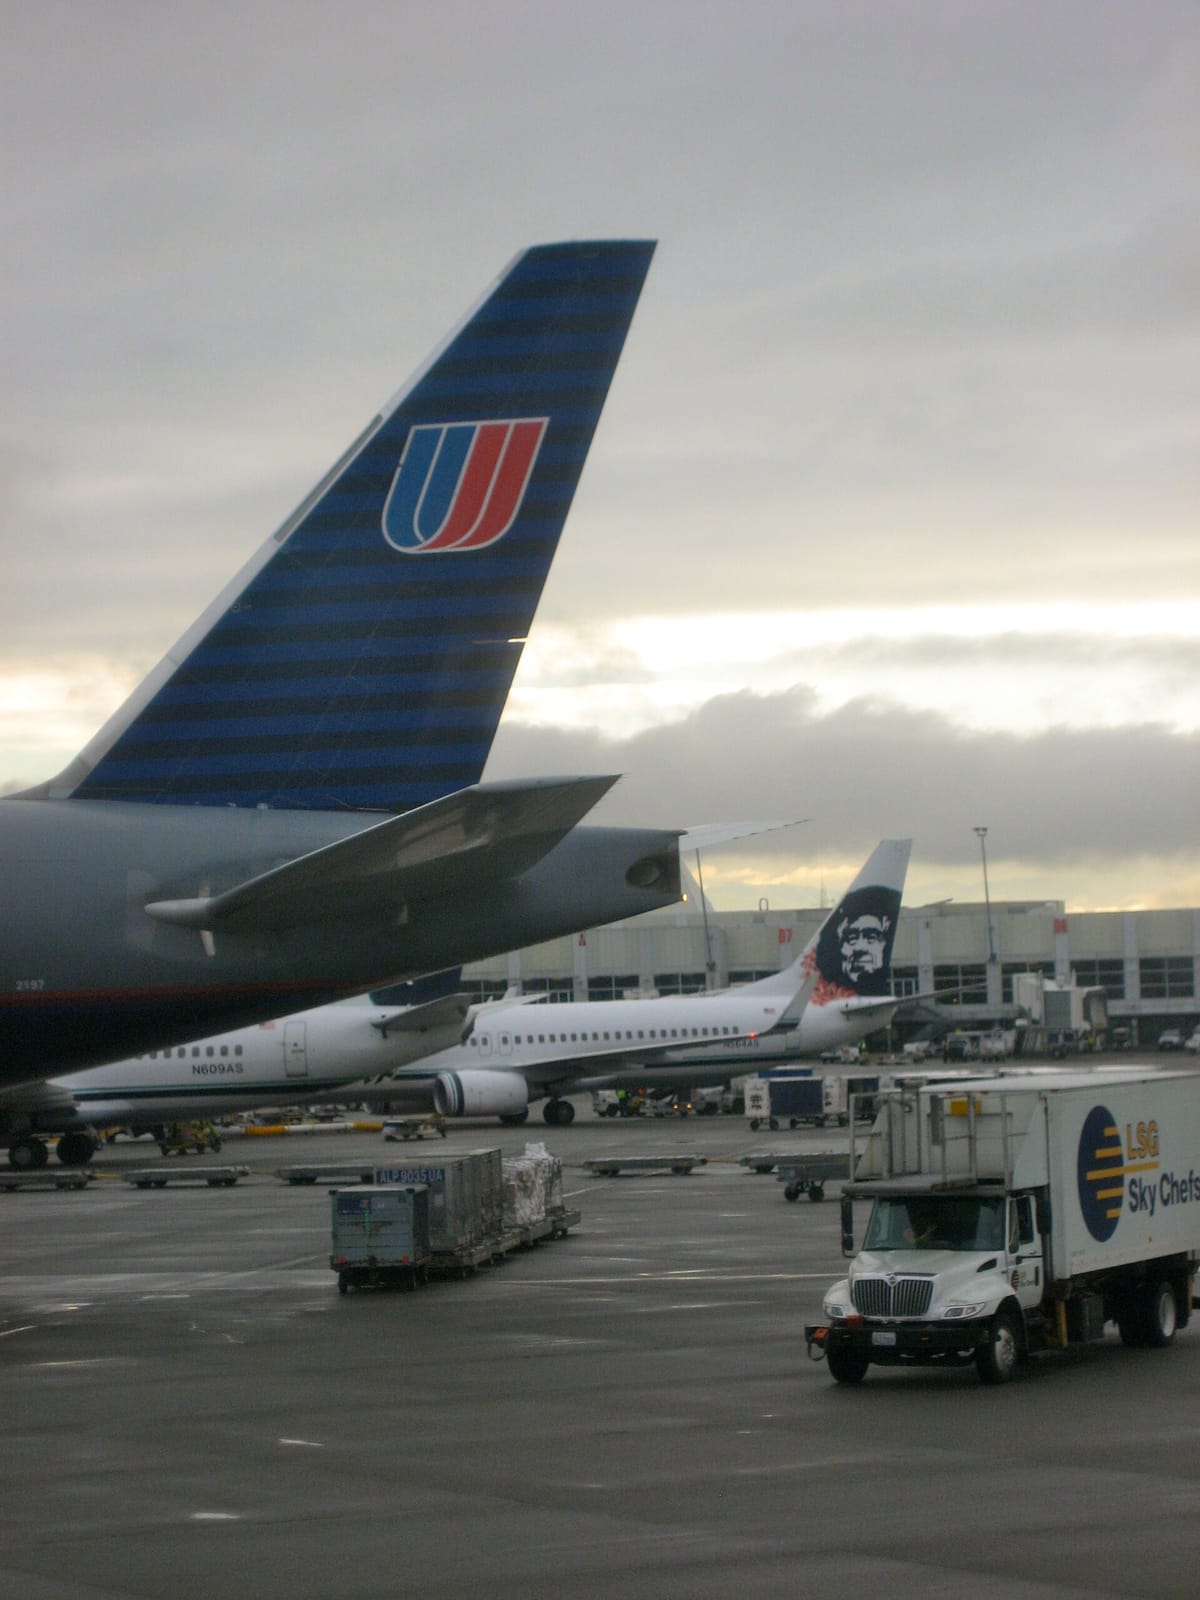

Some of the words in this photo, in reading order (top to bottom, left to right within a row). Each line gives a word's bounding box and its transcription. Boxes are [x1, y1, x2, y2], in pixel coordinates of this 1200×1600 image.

[191, 1063, 244, 1075] N609AS
[1126, 1120, 1160, 1160] LSG
[379, 1168, 400, 1183] ALP
[400, 1168, 428, 1183] 9035
[428, 1168, 445, 1182] UA
[1128, 1178, 1157, 1217] Sky
[1159, 1169, 1200, 1207] Chefs
